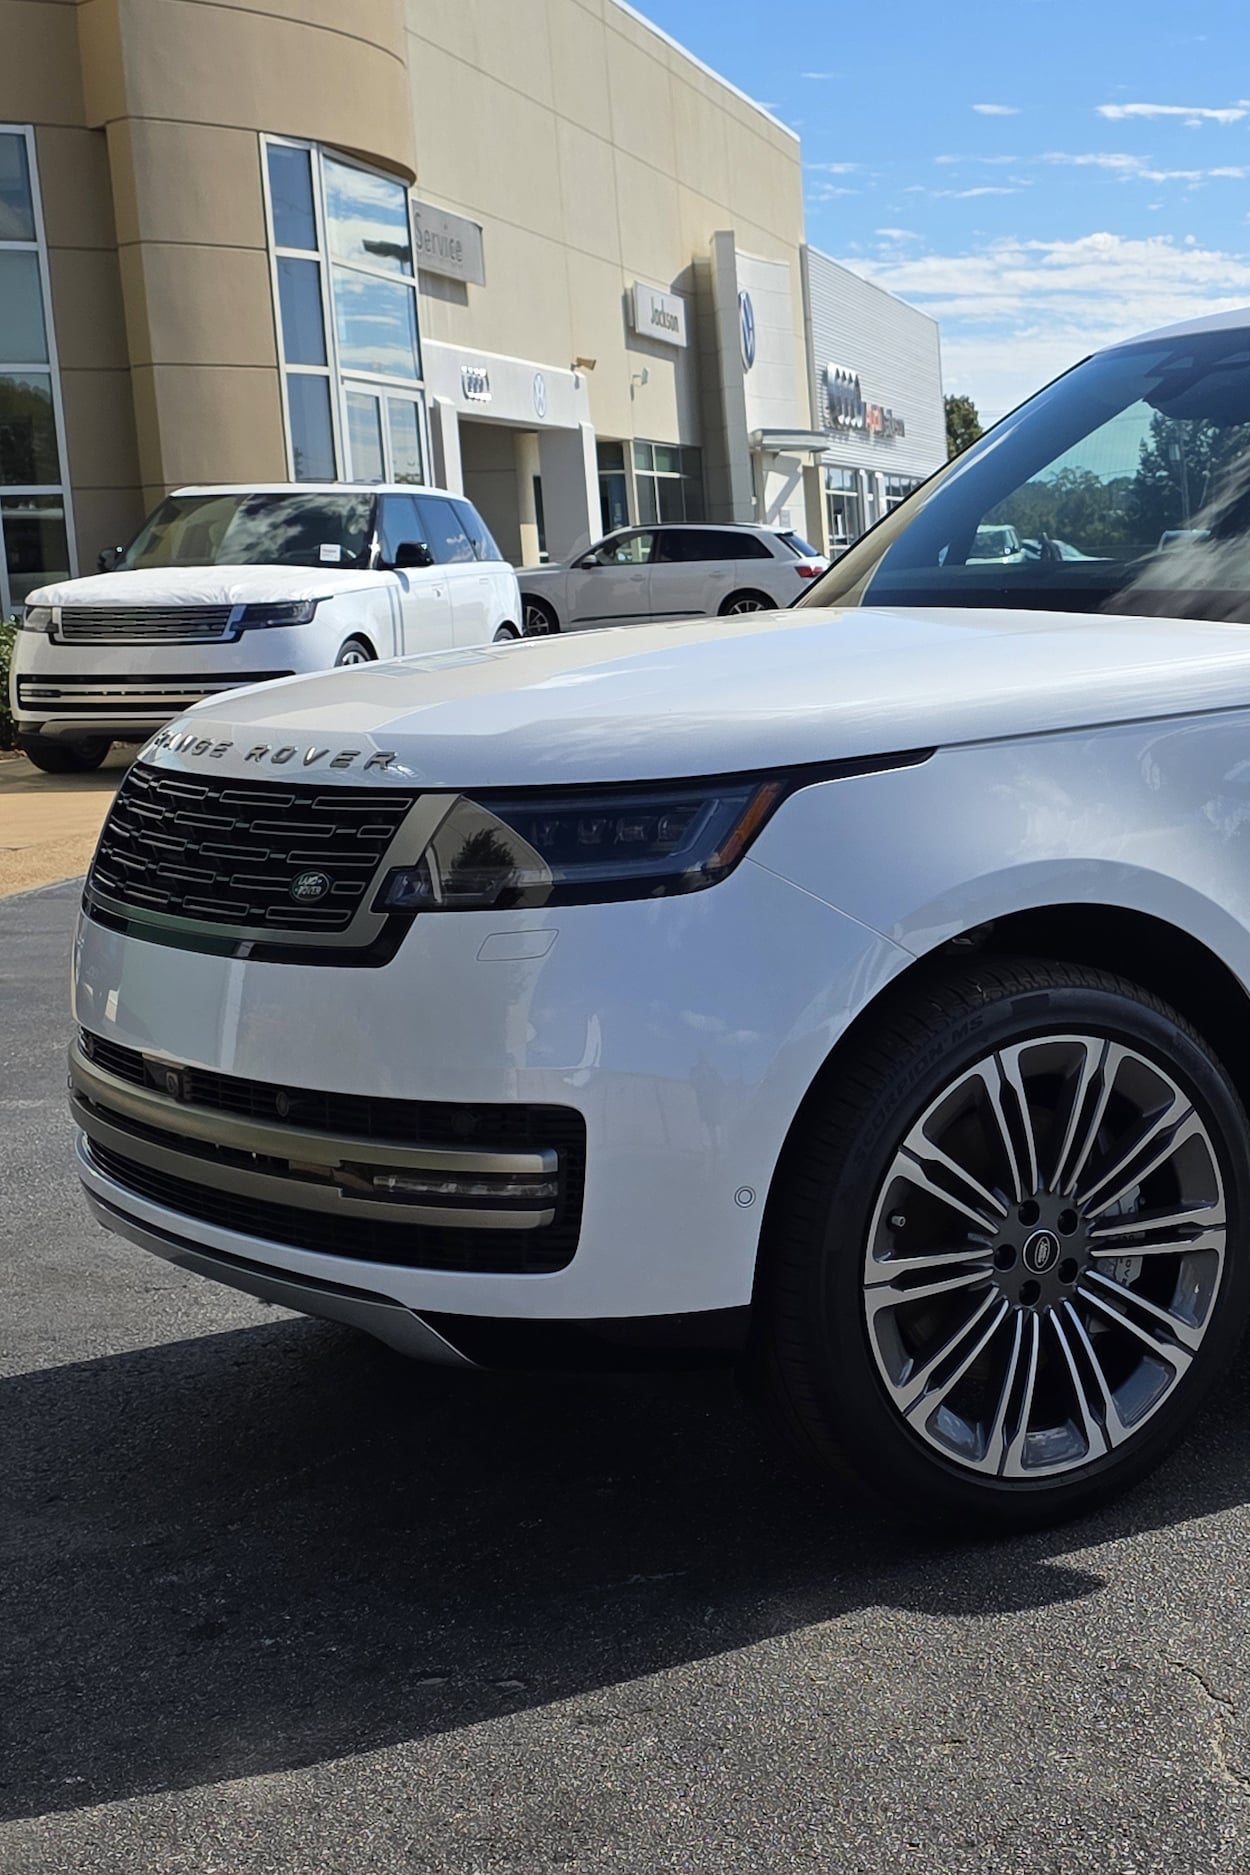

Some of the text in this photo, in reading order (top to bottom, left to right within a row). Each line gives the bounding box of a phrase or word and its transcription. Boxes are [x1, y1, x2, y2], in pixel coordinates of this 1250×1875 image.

[415, 211, 462, 262] Service
[650, 296, 679, 333] Jackson
[153, 729, 398, 772] RANGE ROVER
